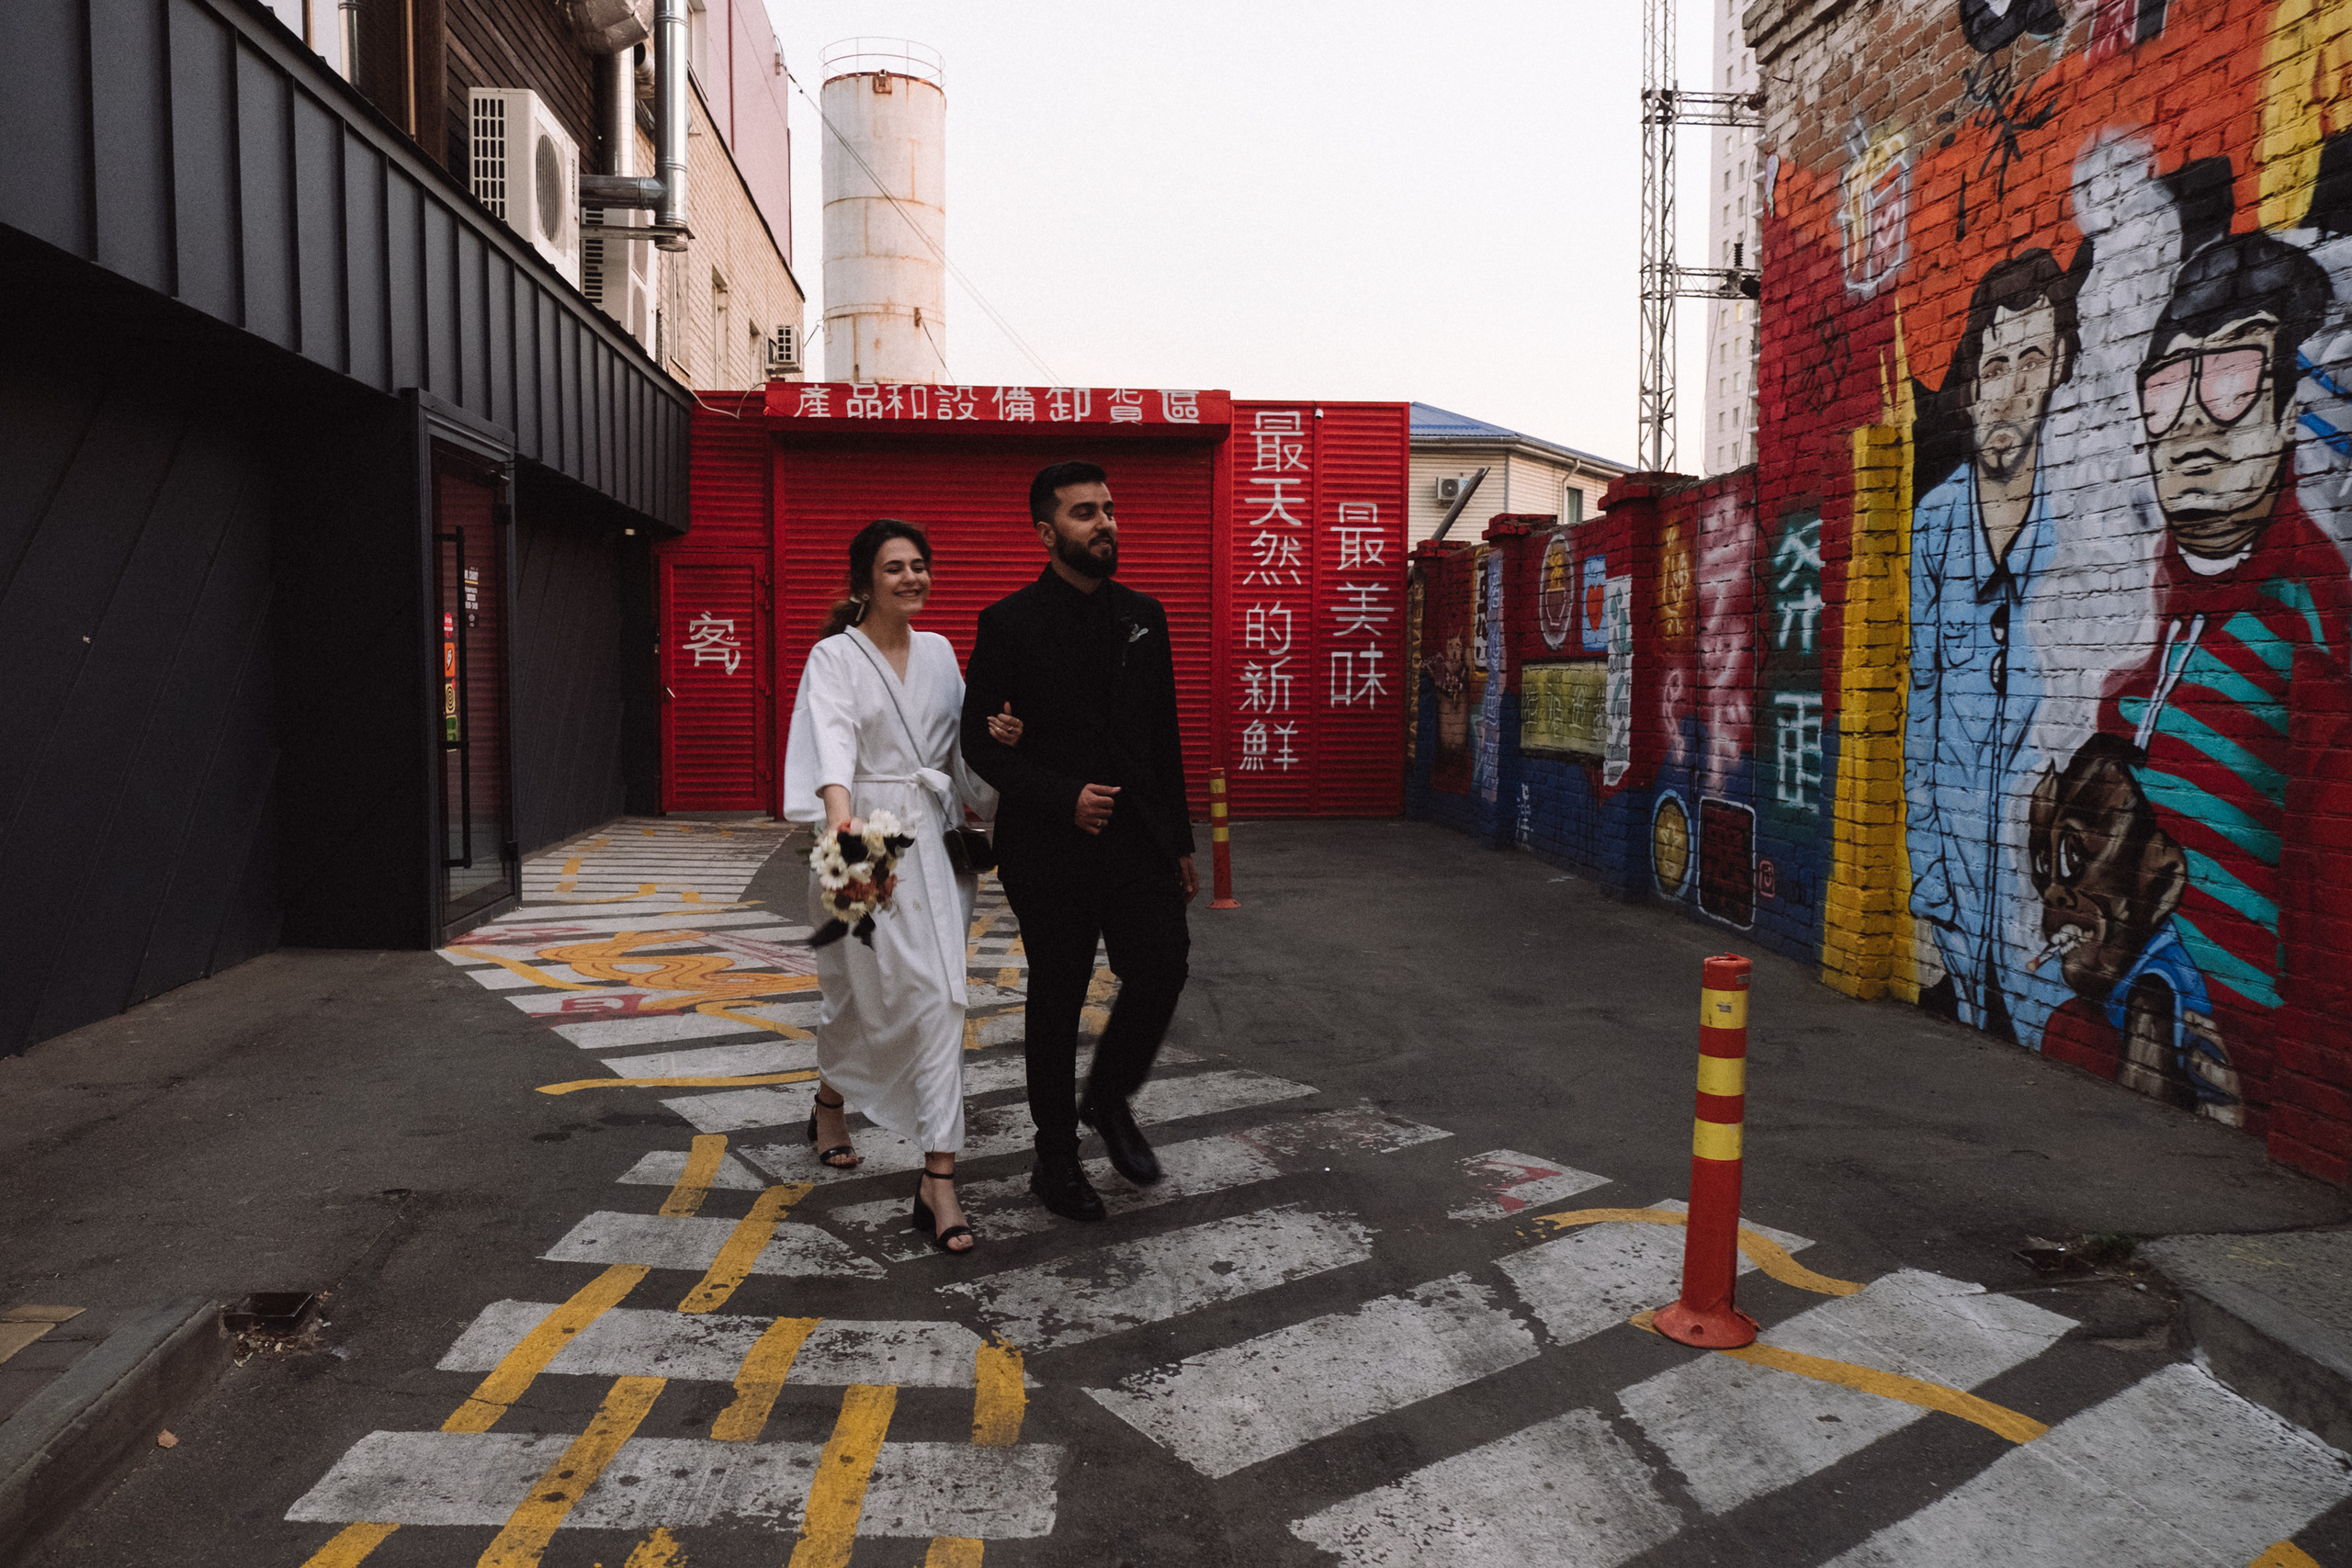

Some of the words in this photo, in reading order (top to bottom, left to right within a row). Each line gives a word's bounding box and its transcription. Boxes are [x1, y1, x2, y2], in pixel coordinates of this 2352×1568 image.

[1239, 411, 1308, 772] 最天然的新鮮
[1330, 502, 1395, 711] 最美味
